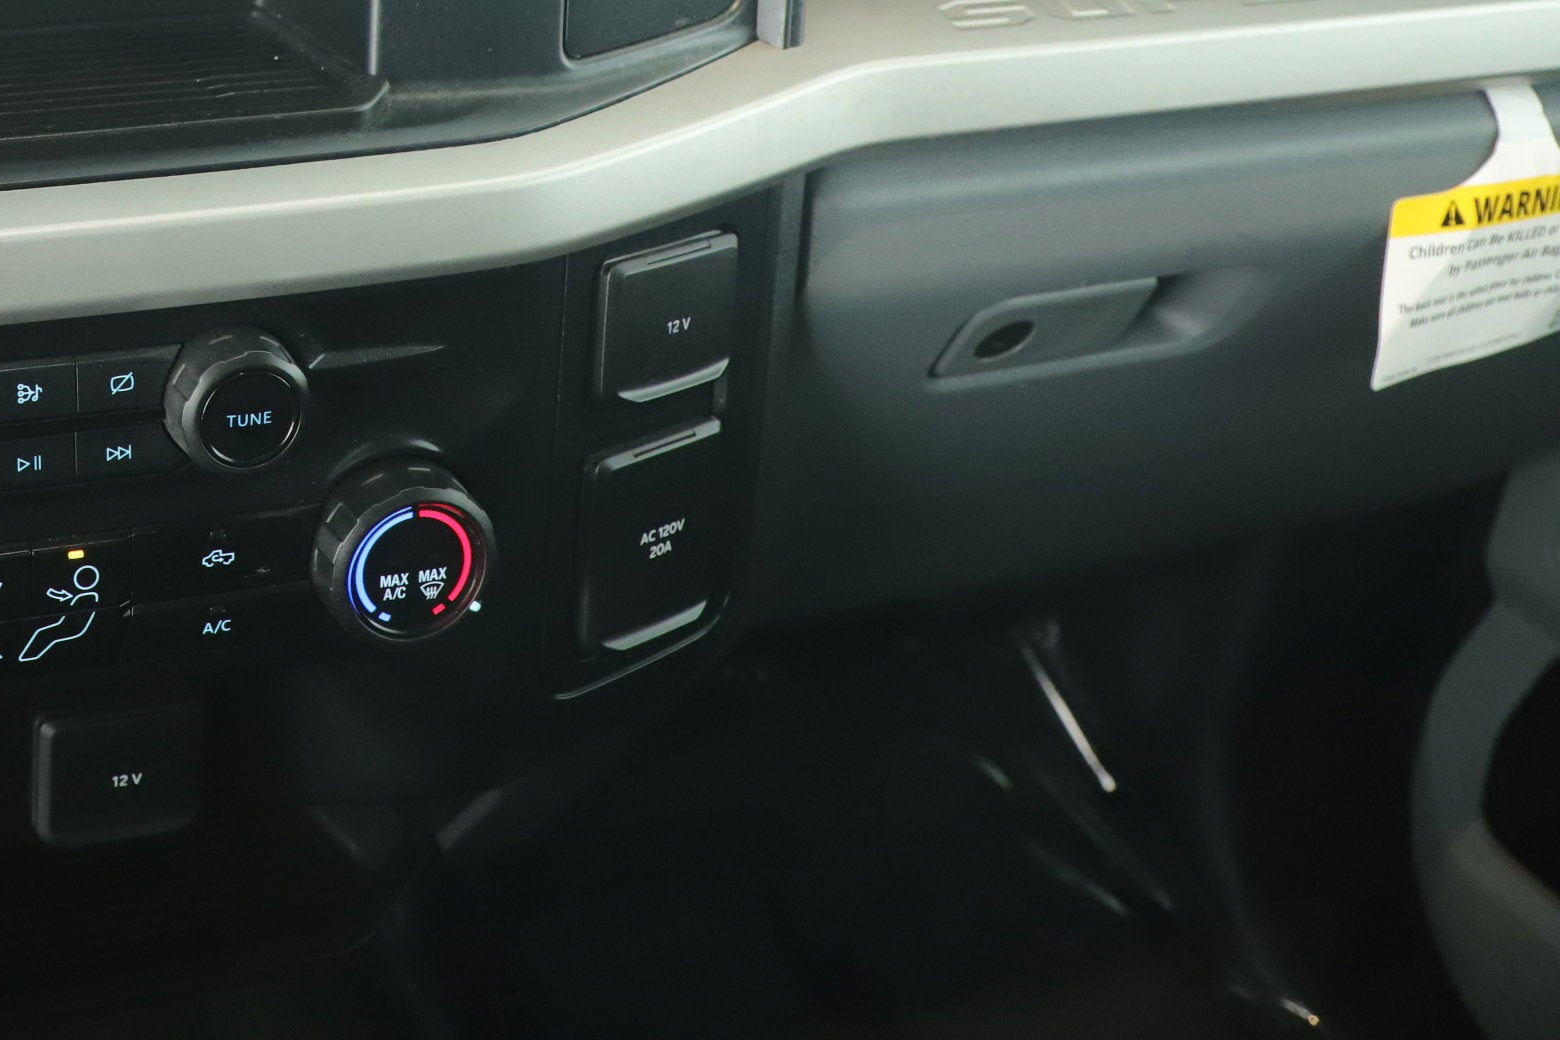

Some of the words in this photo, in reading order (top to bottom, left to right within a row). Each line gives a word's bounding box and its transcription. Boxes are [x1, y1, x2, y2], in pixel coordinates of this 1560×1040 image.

[1408, 243, 1465, 260] Children
[667, 319, 681, 334] 12
[682, 316, 691, 330] V
[226, 410, 272, 428] TUNE
[640, 529, 657, 546] AC
[657, 518, 686, 539] 120V
[646, 539, 672, 559] 20A
[379, 572, 410, 589] MAX
[418, 566, 448, 583] MAX
[382, 586, 407, 601] A/C
[202, 619, 232, 635] A/C
[111, 774, 129, 788] 12
[131, 772, 143, 785] V
